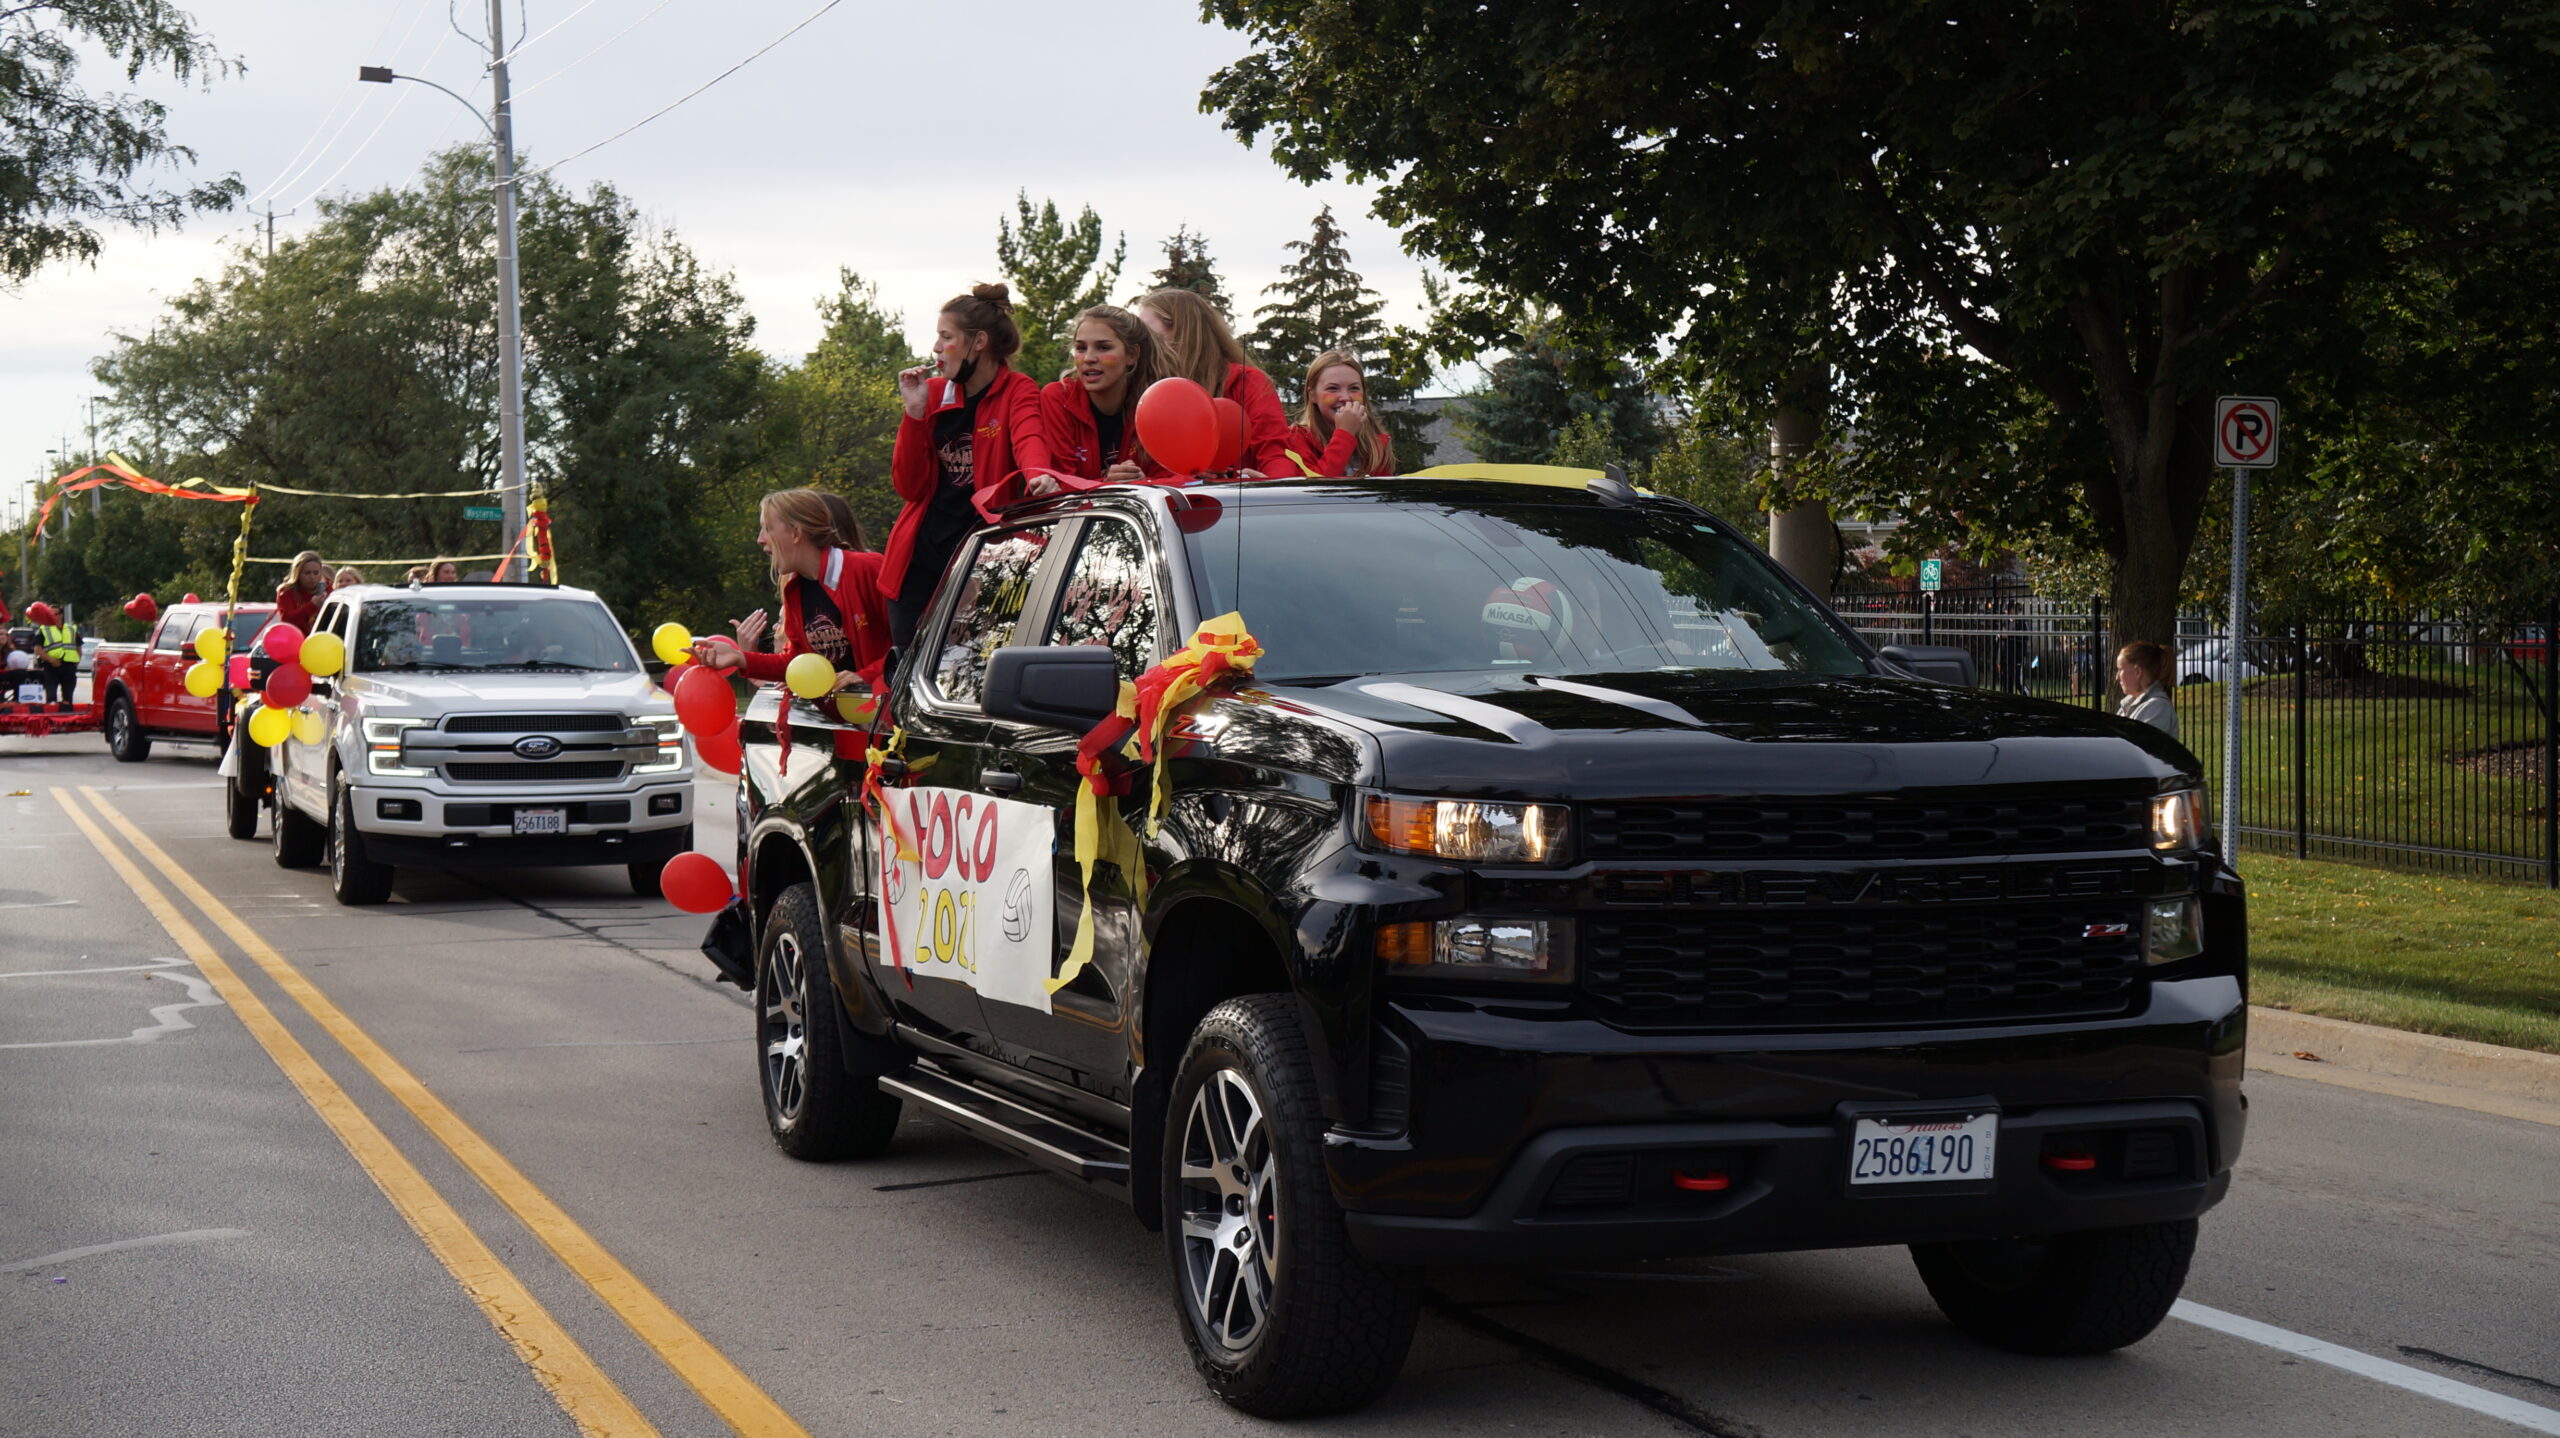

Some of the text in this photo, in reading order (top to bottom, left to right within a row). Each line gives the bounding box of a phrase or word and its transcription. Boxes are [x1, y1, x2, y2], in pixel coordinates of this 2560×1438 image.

[526, 742, 550, 753] Ford
[909, 790, 999, 884] HOCO
[1604, 868, 2150, 906] CHEVROLET
[915, 887, 977, 975] 2021
[1855, 1134, 1974, 1178] 2586190
